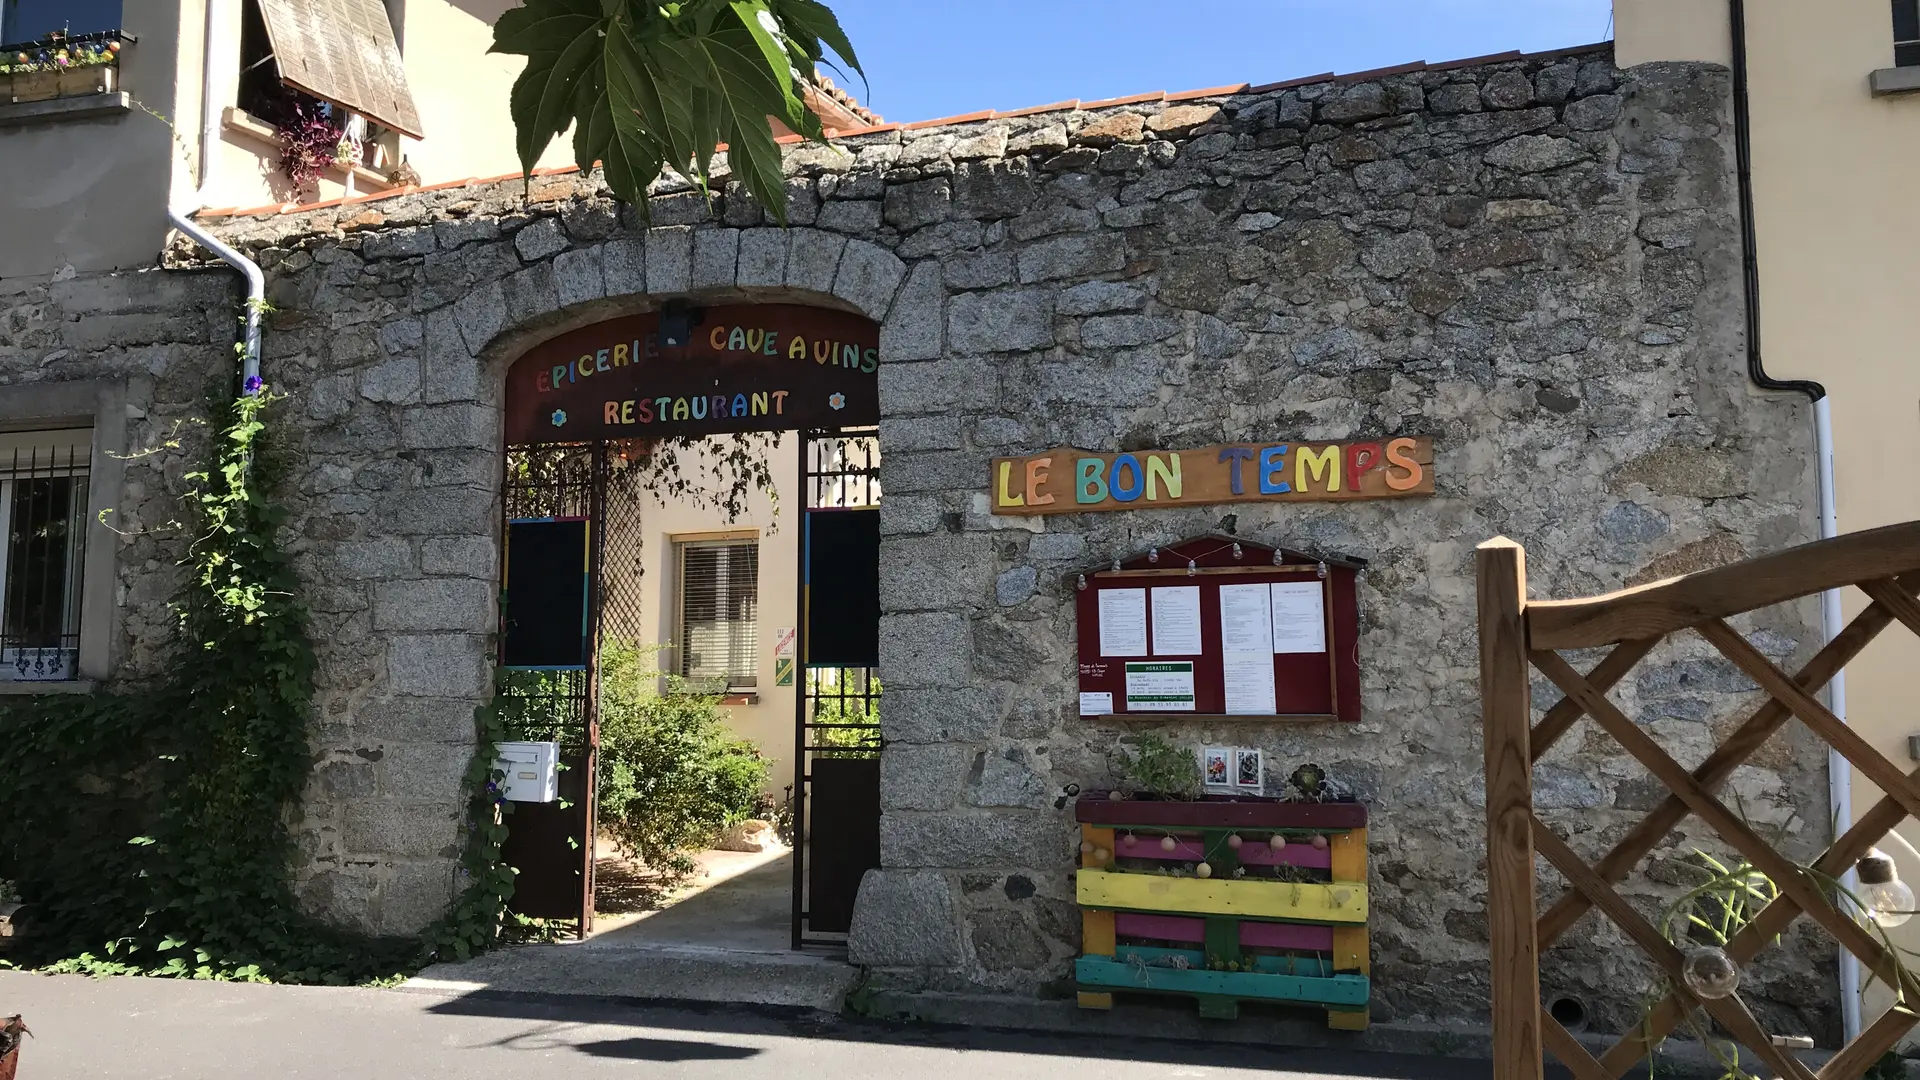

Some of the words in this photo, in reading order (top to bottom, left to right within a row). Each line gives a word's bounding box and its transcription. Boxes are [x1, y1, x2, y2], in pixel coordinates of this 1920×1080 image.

[536, 332, 660, 393] EPICERIE
[710, 325, 778, 356] CAVE
[788, 335, 806, 360] A
[813, 340, 878, 374] VINS
[604, 390, 789, 425] RESTAURANT
[998, 457, 1055, 507] LE
[1076, 452, 1183, 504] BON
[1219, 437, 1423, 496] TEMPS
